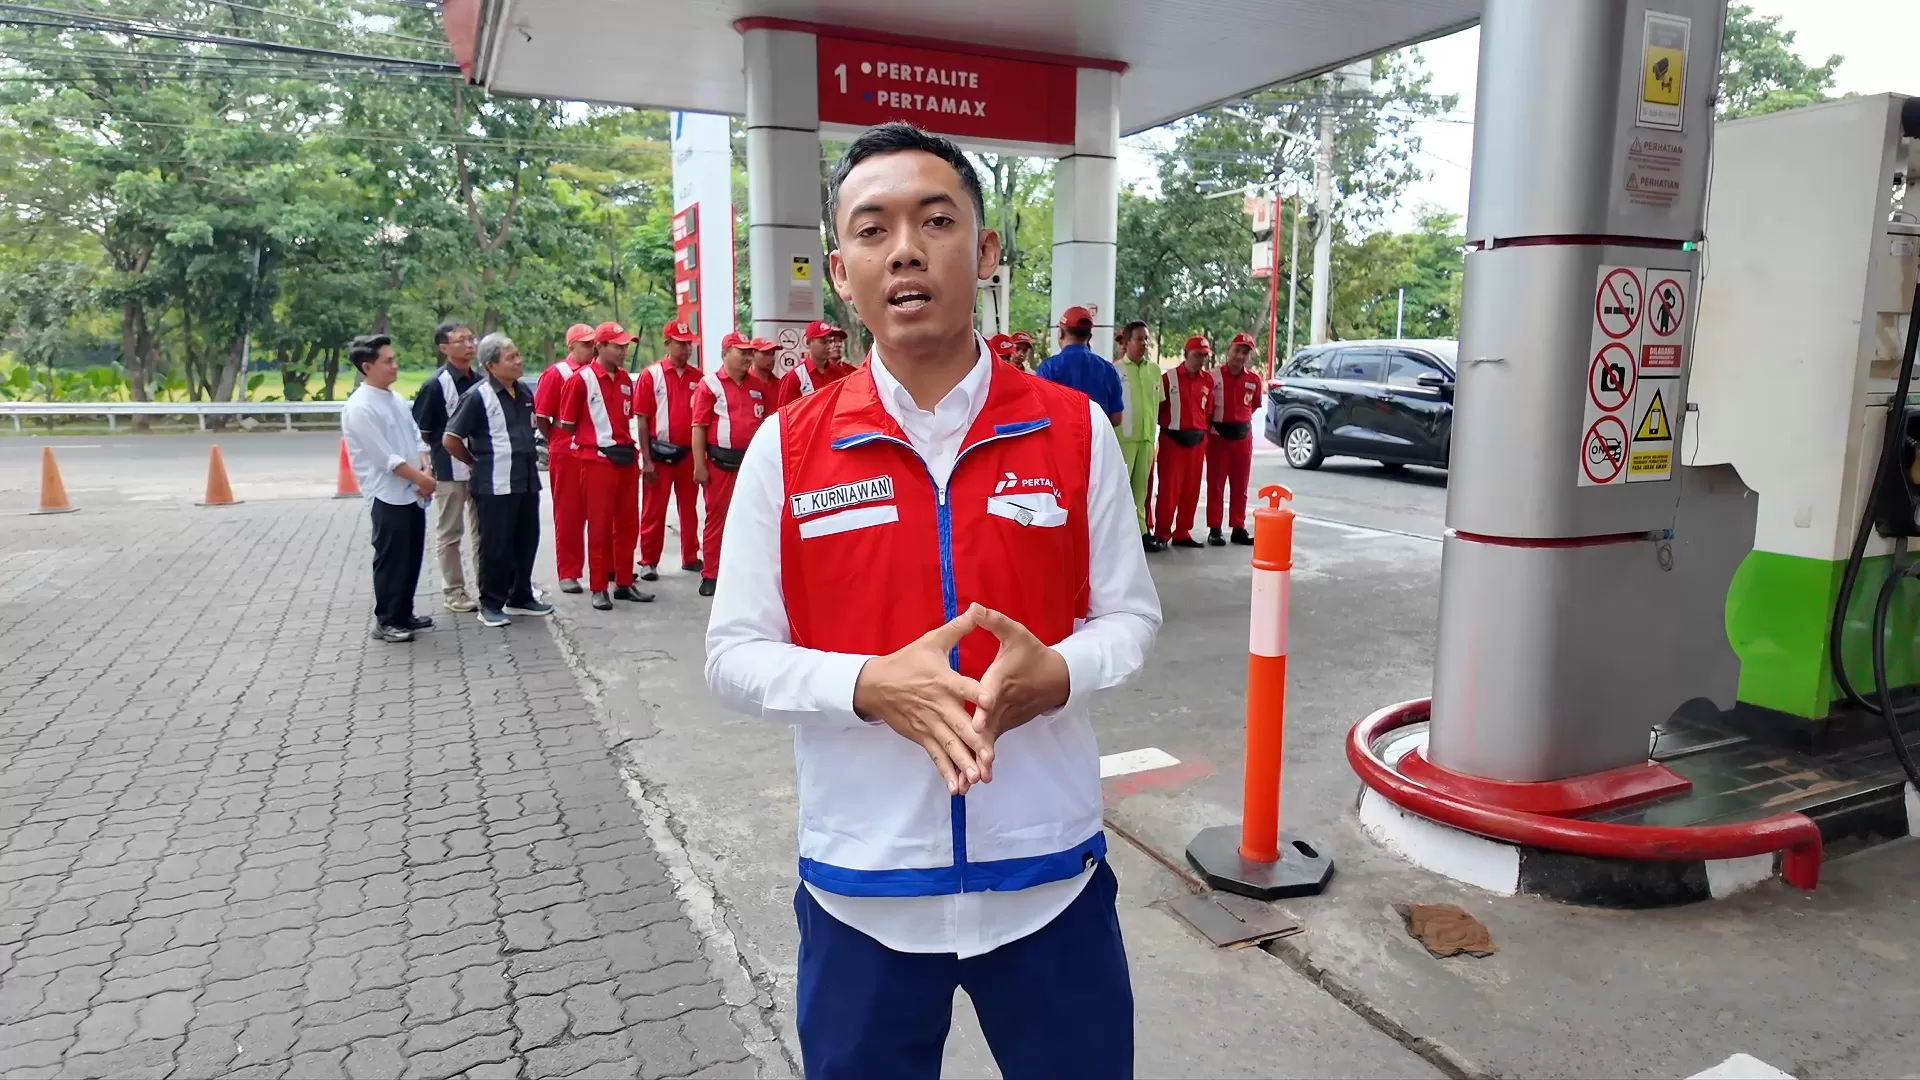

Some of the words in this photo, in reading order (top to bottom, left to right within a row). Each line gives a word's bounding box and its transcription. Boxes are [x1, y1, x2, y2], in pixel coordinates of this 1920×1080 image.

[834, 63, 848, 94] 1
[876, 61, 979, 89] PERTALITE
[877, 90, 987, 117] PERTAMAX
[1643, 141, 1683, 154] PERHATIAN
[1640, 176, 1680, 189] PERHATIAN
[794, 497, 806, 513] T.
[811, 478, 888, 510] KURNIAWAN
